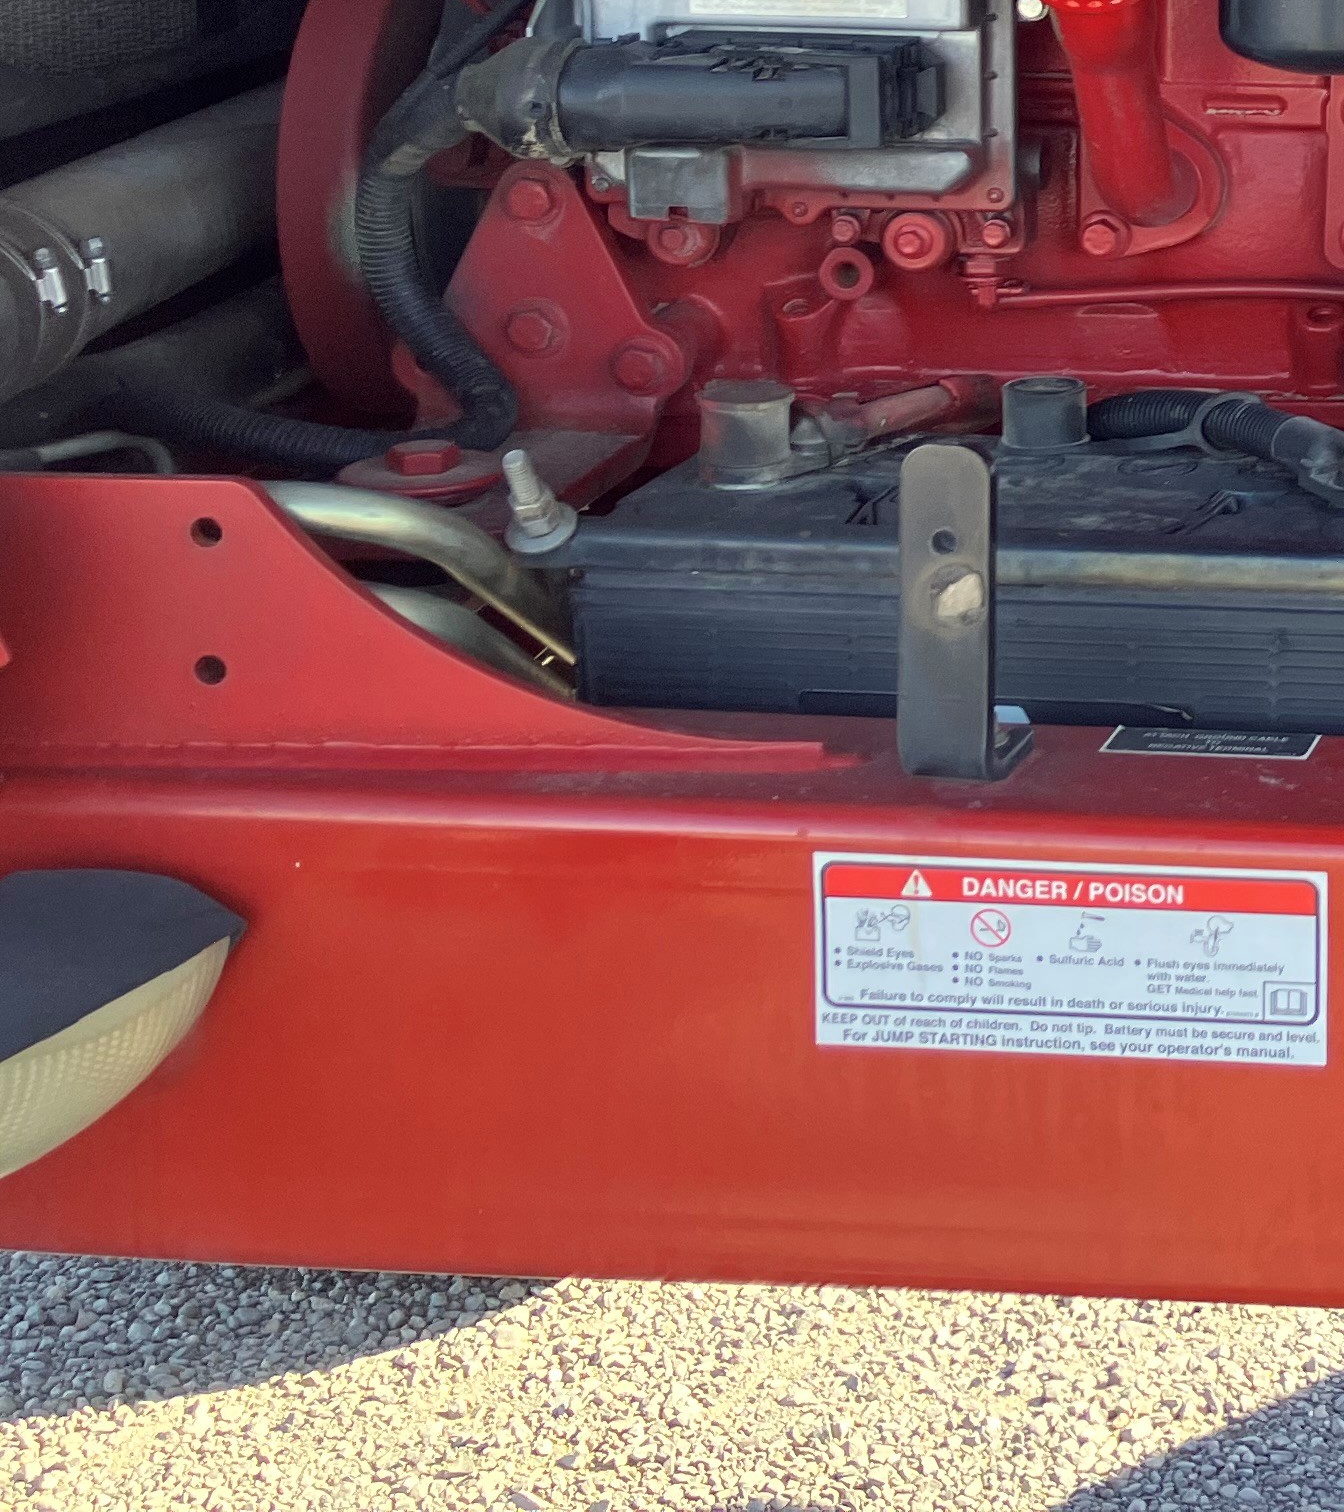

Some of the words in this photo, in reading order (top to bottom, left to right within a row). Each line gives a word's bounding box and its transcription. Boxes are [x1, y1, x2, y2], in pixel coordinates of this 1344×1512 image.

[962, 877, 1068, 900] DANGER
[1072, 881, 1084, 901] /
[1088, 882, 1184, 905] POISON
[847, 946, 883, 957] Shield
[887, 947, 915, 960] Eyes
[964, 951, 983, 961] NO
[988, 953, 1023, 964] Sparks
[847, 959, 903, 971] Explosive
[907, 961, 944, 972] Gases
[1049, 954, 1094, 966] Sulfuric
[1098, 956, 1125, 967] Acid
[1147, 958, 1180, 970] Flush
[1182, 961, 1210, 972] eyes
[1213, 961, 1285, 975] immediately
[964, 964, 983, 974] NO
[988, 965, 1024, 975] Flames
[964, 976, 983, 987] NO
[988, 979, 1032, 990] Smoking
[1147, 972, 1172, 982] with
[1147, 984, 1172, 994] GET
[1175, 985, 1212, 996] Medical
[1215, 986, 1236, 998] help
[859, 988, 906, 1002] Failure
[910, 991, 924, 1003] to
[927, 992, 977, 1007] comply
[981, 992, 1004, 1005] will
[1008, 994, 1046, 1008] result
[1051, 995, 1063, 1007] in
[1067, 997, 1105, 1010] death
[1109, 1000, 1124, 1010] or
[1127, 1000, 1178, 1013] serious
[1182, 1001, 1225, 1018] injury.
[822, 1012, 858, 1024] KEEP
[861, 1014, 890, 1025] OUT
[893, 1015, 906, 1026] of
[910, 1016, 947, 1028] reach
[950, 1017, 962, 1028] of
[966, 1018, 1022, 1031] children.
[1030, 1021, 1048, 1032] Do
[1052, 1022, 1073, 1033] not
[1076, 1020, 1097, 1034] tip.
[1104, 1023, 1152, 1039] Battery
[1156, 1026, 1188, 1038] must
[1192, 1027, 1208, 1039] be
[1211, 1029, 1255, 1041] secure
[1259, 1030, 1283, 1041] and
[843, 1029, 867, 1042] For
[871, 1030, 914, 1044] JUMP
[919, 1031, 997, 1046] STARTING
[1001, 1033, 1085, 1052] instruction,
[1090, 1041, 1115, 1051] see
[1120, 1042, 1153, 1055] your
[1157, 1043, 1232, 1057] operator's
[1236, 1046, 1295, 1059] manual.
